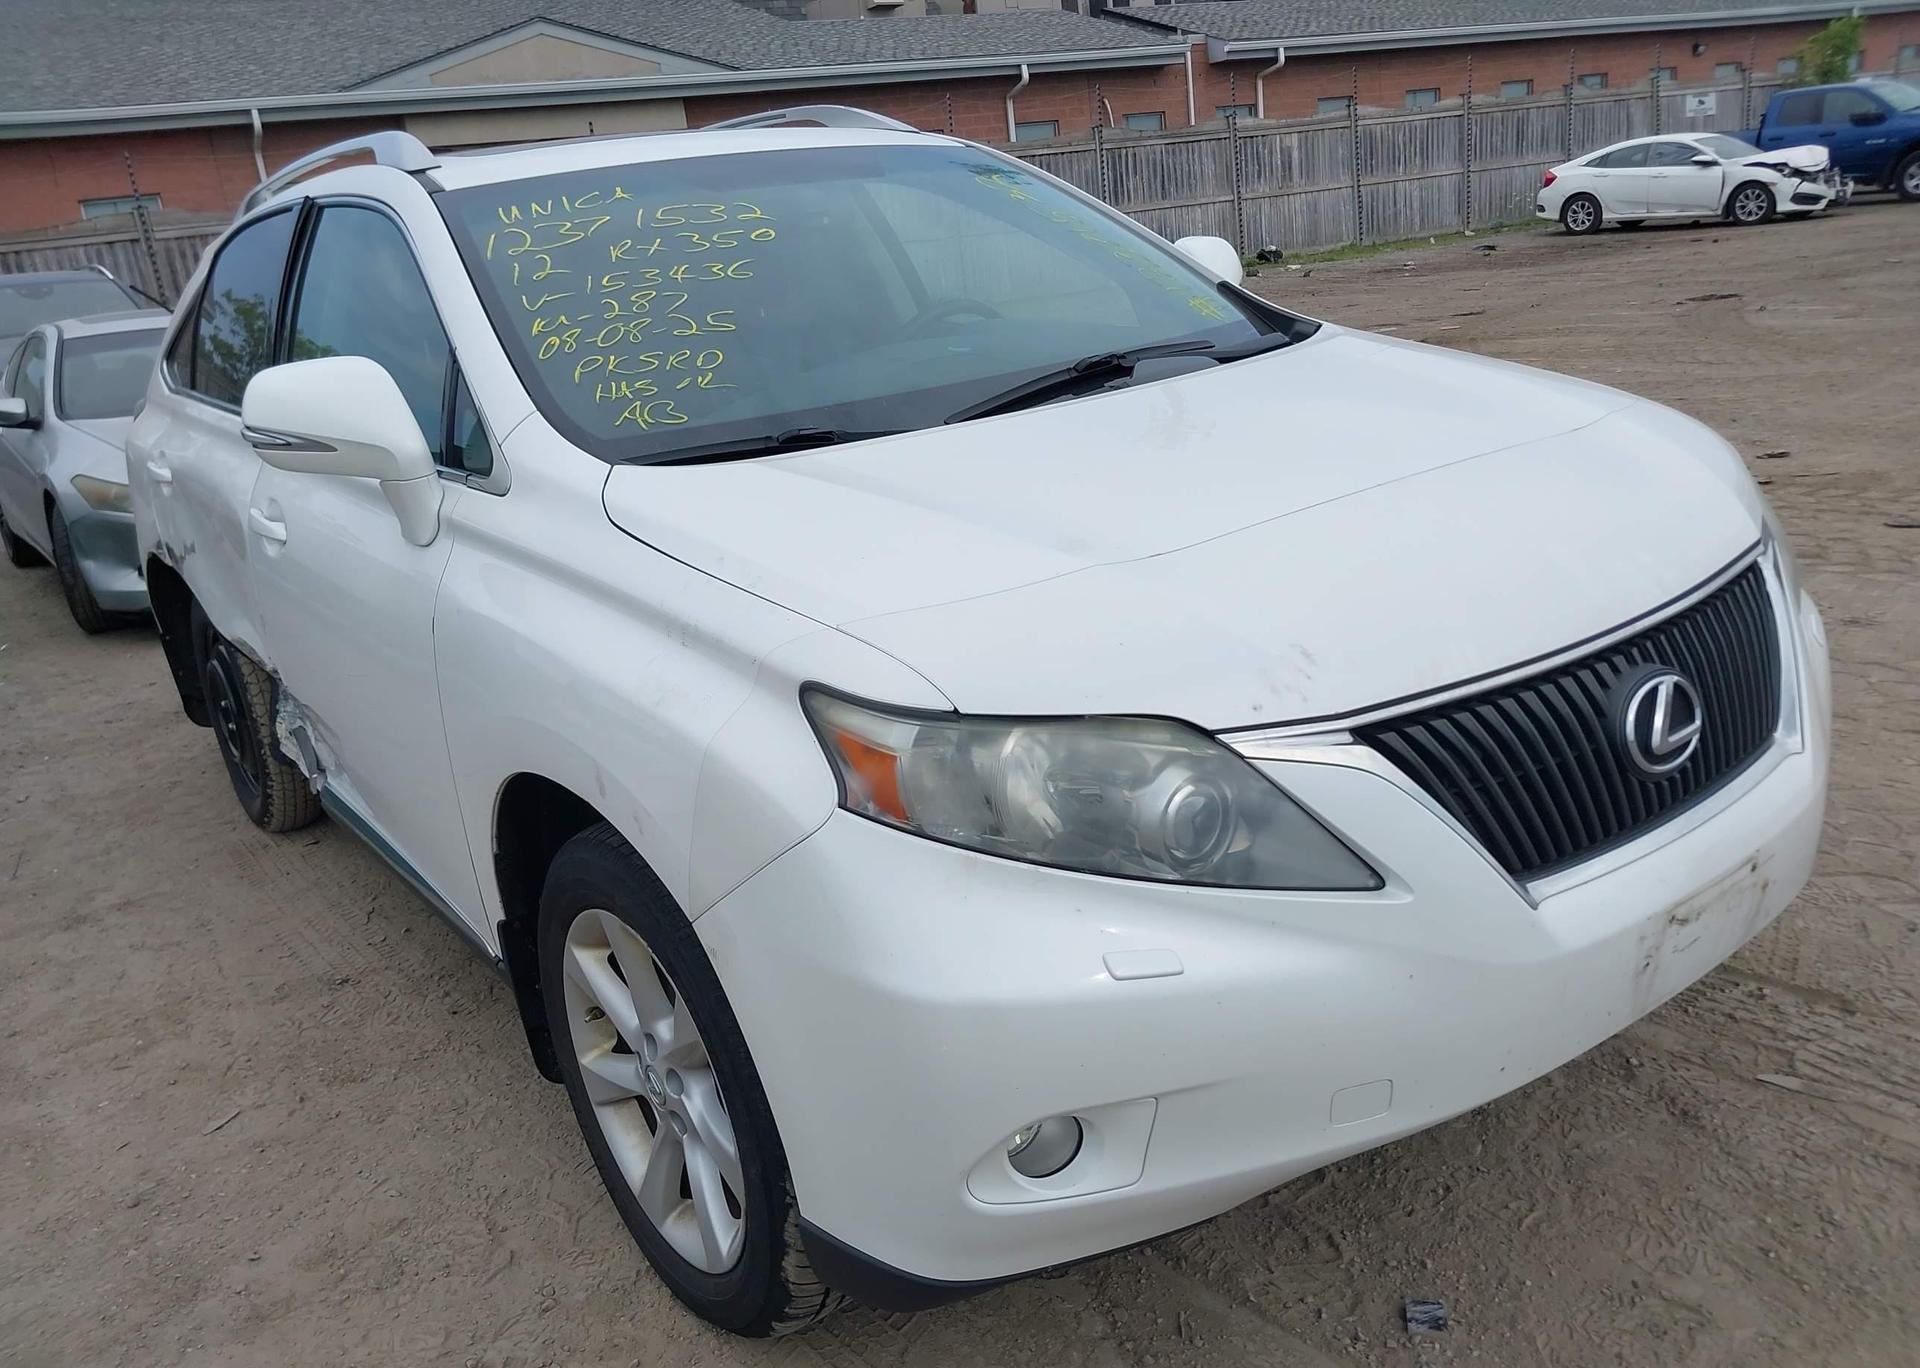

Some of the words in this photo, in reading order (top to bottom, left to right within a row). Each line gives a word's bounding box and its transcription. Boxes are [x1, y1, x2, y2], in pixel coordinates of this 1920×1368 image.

[486, 215, 611, 261] 1237
[636, 203, 777, 229] 1532
[512, 254, 573, 286] 12
[537, 310, 736, 360] 08-08-25
